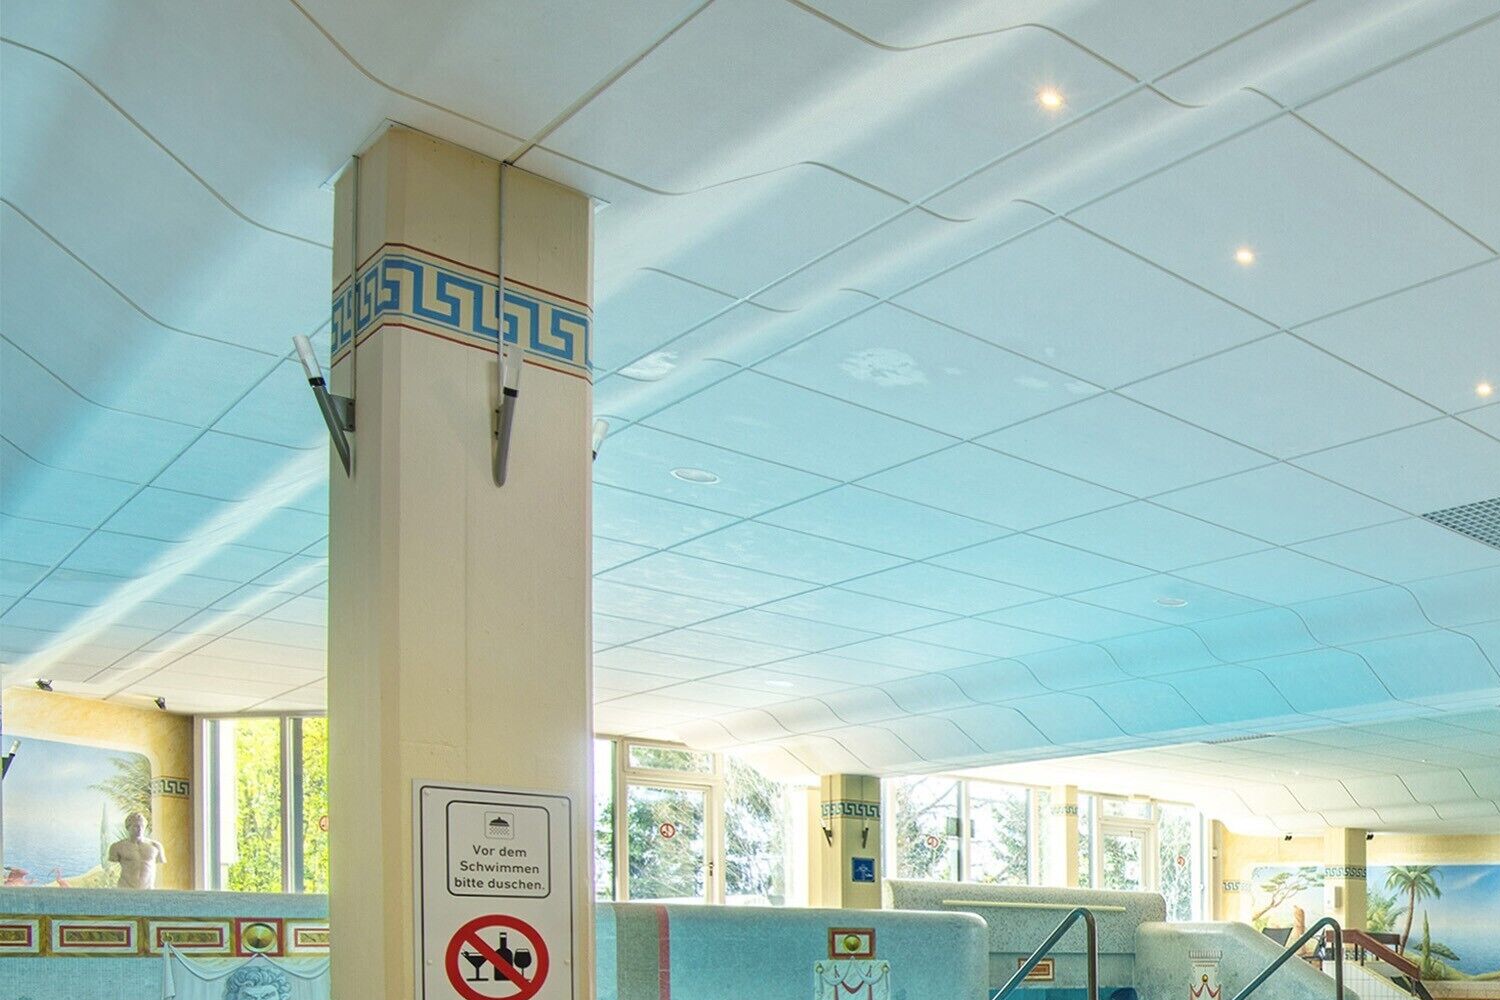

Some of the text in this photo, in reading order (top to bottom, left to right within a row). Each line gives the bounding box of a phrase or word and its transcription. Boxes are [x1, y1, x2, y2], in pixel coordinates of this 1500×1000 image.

[472, 844, 527, 858] Vor dem
[459, 860, 540, 874] Schwimmen
[454, 876, 545, 891] bitte duschen.
